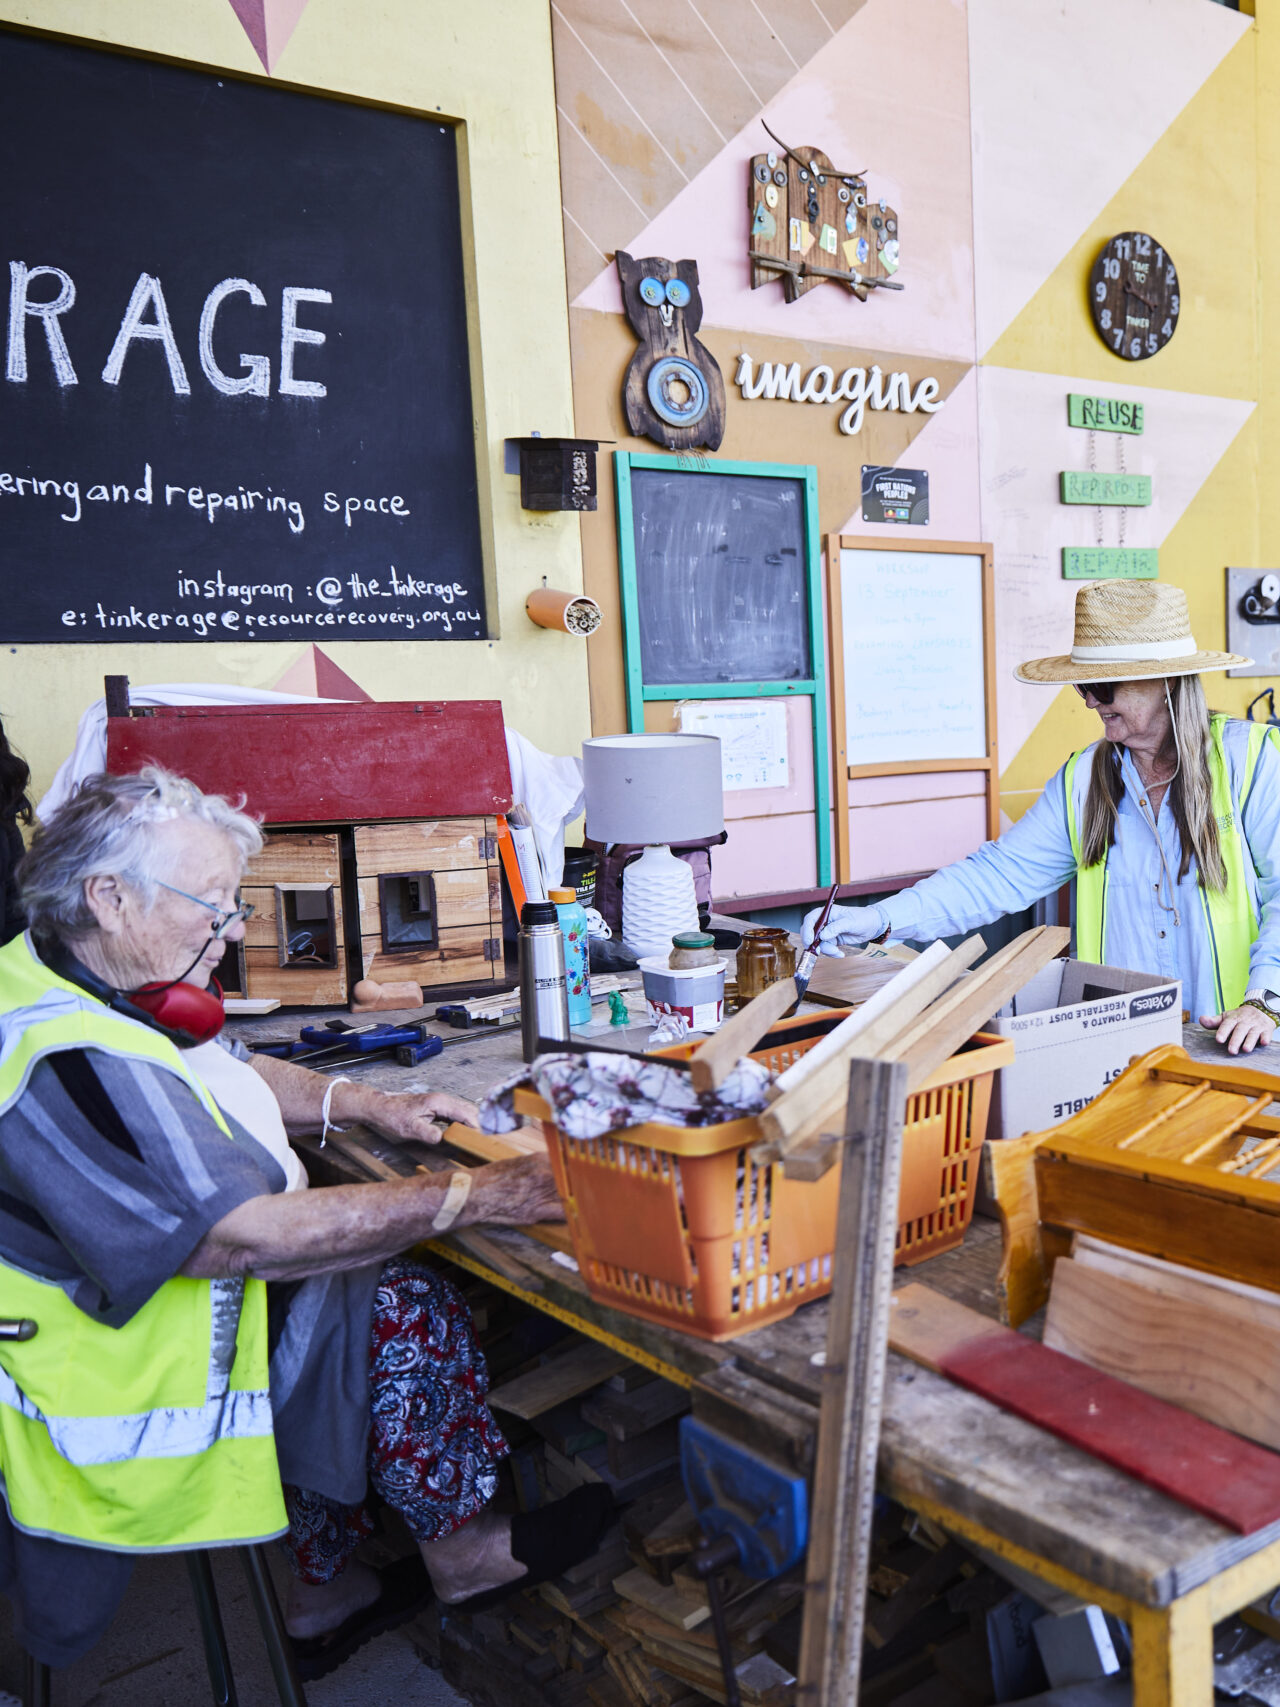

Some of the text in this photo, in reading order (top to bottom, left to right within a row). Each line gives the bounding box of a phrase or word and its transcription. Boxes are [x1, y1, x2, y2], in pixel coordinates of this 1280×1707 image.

[1115, 239, 1130, 260] 11
[1134, 234, 1151, 256] 12
[1132, 260, 1150, 274] TIME
[1155, 247, 1164, 268] 1
[1103, 258, 1120, 280] 10
[1135, 271, 1147, 284] TO
[1166, 264, 1176, 285] 2
[1096, 281, 1107, 302] 9
[1170, 295, 1180, 315] 3
[1101, 309, 1112, 330] 8
[1162, 318, 1172, 338] 4
[1113, 328, 1124, 350] 7
[1130, 338, 1141, 358] 6
[1148, 333, 1158, 353] 5
[735, 353, 945, 436] imagine
[1082, 398, 1143, 430] REUSE
[165, 485, 305, 534] repairing
[323, 491, 411, 528] space
[177, 569, 294, 605] instagram
[61, 610, 87, 627] e:
[1049, 1001, 1126, 1024] VEGETABLE DUST
[1136, 995, 1166, 1011] Yates
[1091, 1013, 1127, 1028] TOMATO
